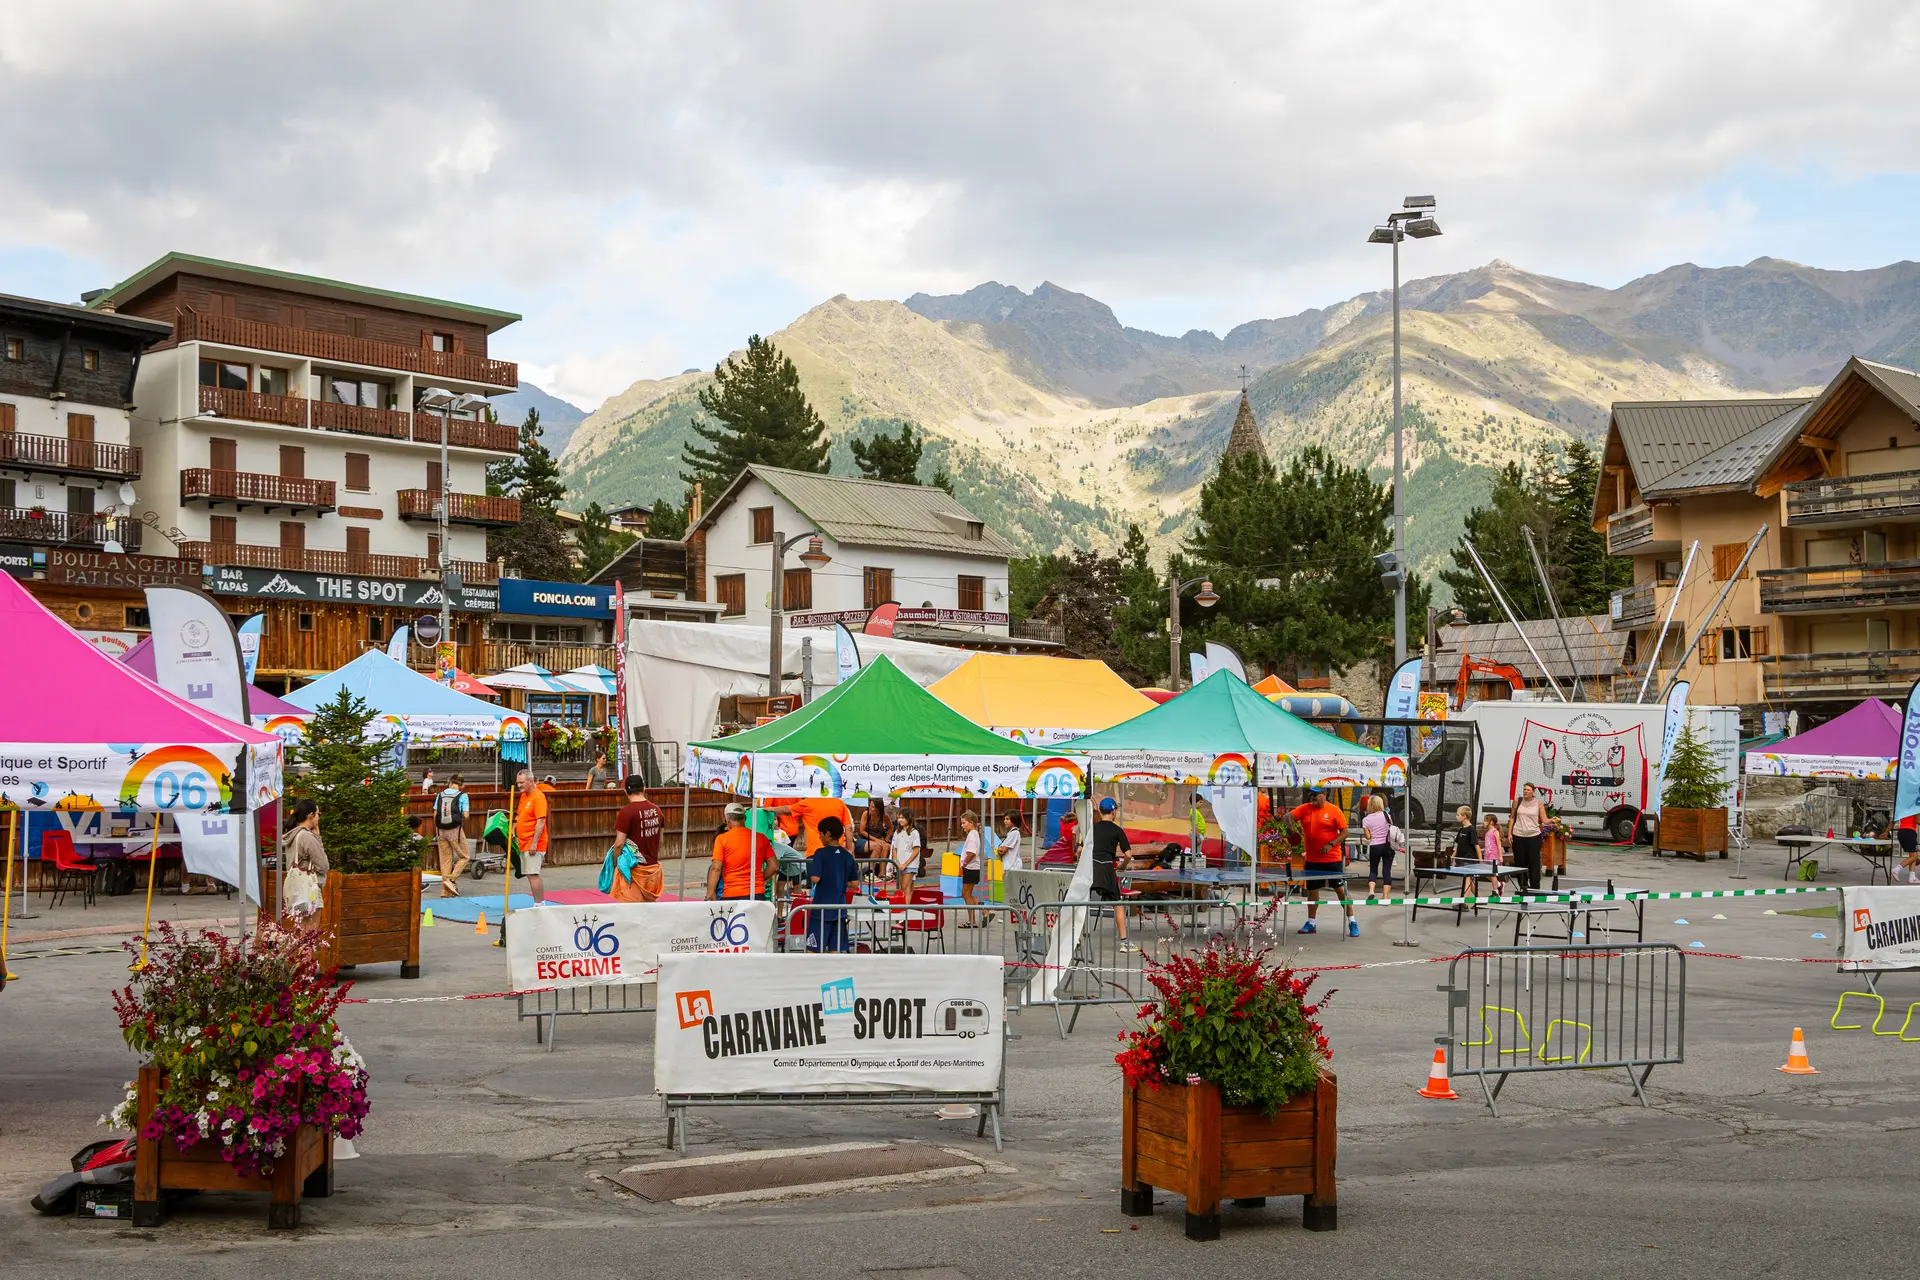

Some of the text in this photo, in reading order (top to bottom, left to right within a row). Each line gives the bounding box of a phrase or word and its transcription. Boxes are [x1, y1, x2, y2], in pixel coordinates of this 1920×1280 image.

[0, 555, 28, 567] PORTS
[52, 550, 200, 576] BOULANGERIE
[65, 568, 182, 588] PATISSERIE
[221, 568, 243, 580] BAR
[217, 580, 249, 593] TAPAS
[316, 577, 407, 603] THE SPOT
[461, 587, 498, 599] RESTAURANT
[533, 592, 596, 607] FONCIA.COM
[896, 610, 936, 620] haumiere
[101, 635, 131, 652] Boulang
[1587, 712, 1613, 728] NATIONAL
[506, 726, 522, 740] 06
[1903, 707, 1920, 770] SPORT
[38, 756, 53, 769] et
[57, 756, 108, 773] Sportif
[1104, 753, 1145, 763] Départemental
[1145, 754, 1176, 764] Olympique
[1184, 755, 1204, 764] Sportif
[1125, 762, 1172, 770] Alpes-Maritimes
[1310, 758, 1340, 767] Départemental
[1834, 759, 1859, 767] Olympique
[840, 762, 1020, 774] Comité Départemental Olympique et Sportif
[890, 773, 974, 783] des Alpes-Maritimes
[1043, 772, 1074, 797] 06
[153, 769, 208, 810] 06
[643, 808, 658, 819] HOPE
[1018, 885, 1035, 910] 06
[1854, 912, 1871, 930] La
[709, 912, 750, 946] 06
[573, 922, 620, 957] 06
[670, 935, 699, 945] COMITÉ
[671, 941, 730, 953] DÉPARTEMENTAL
[535, 945, 564, 954] COMITÉ
[536, 950, 597, 962] DÉPARTEMENTAL
[537, 956, 622, 980] ESCRIME
[823, 986, 854, 1012] du
[681, 996, 707, 1024] La
[853, 998, 926, 1040] SPORT
[703, 1002, 827, 1060] CARAVANE
[773, 1058, 985, 1070] Comité Départemental Olympique et Sportif des Alpes-Maritimes
